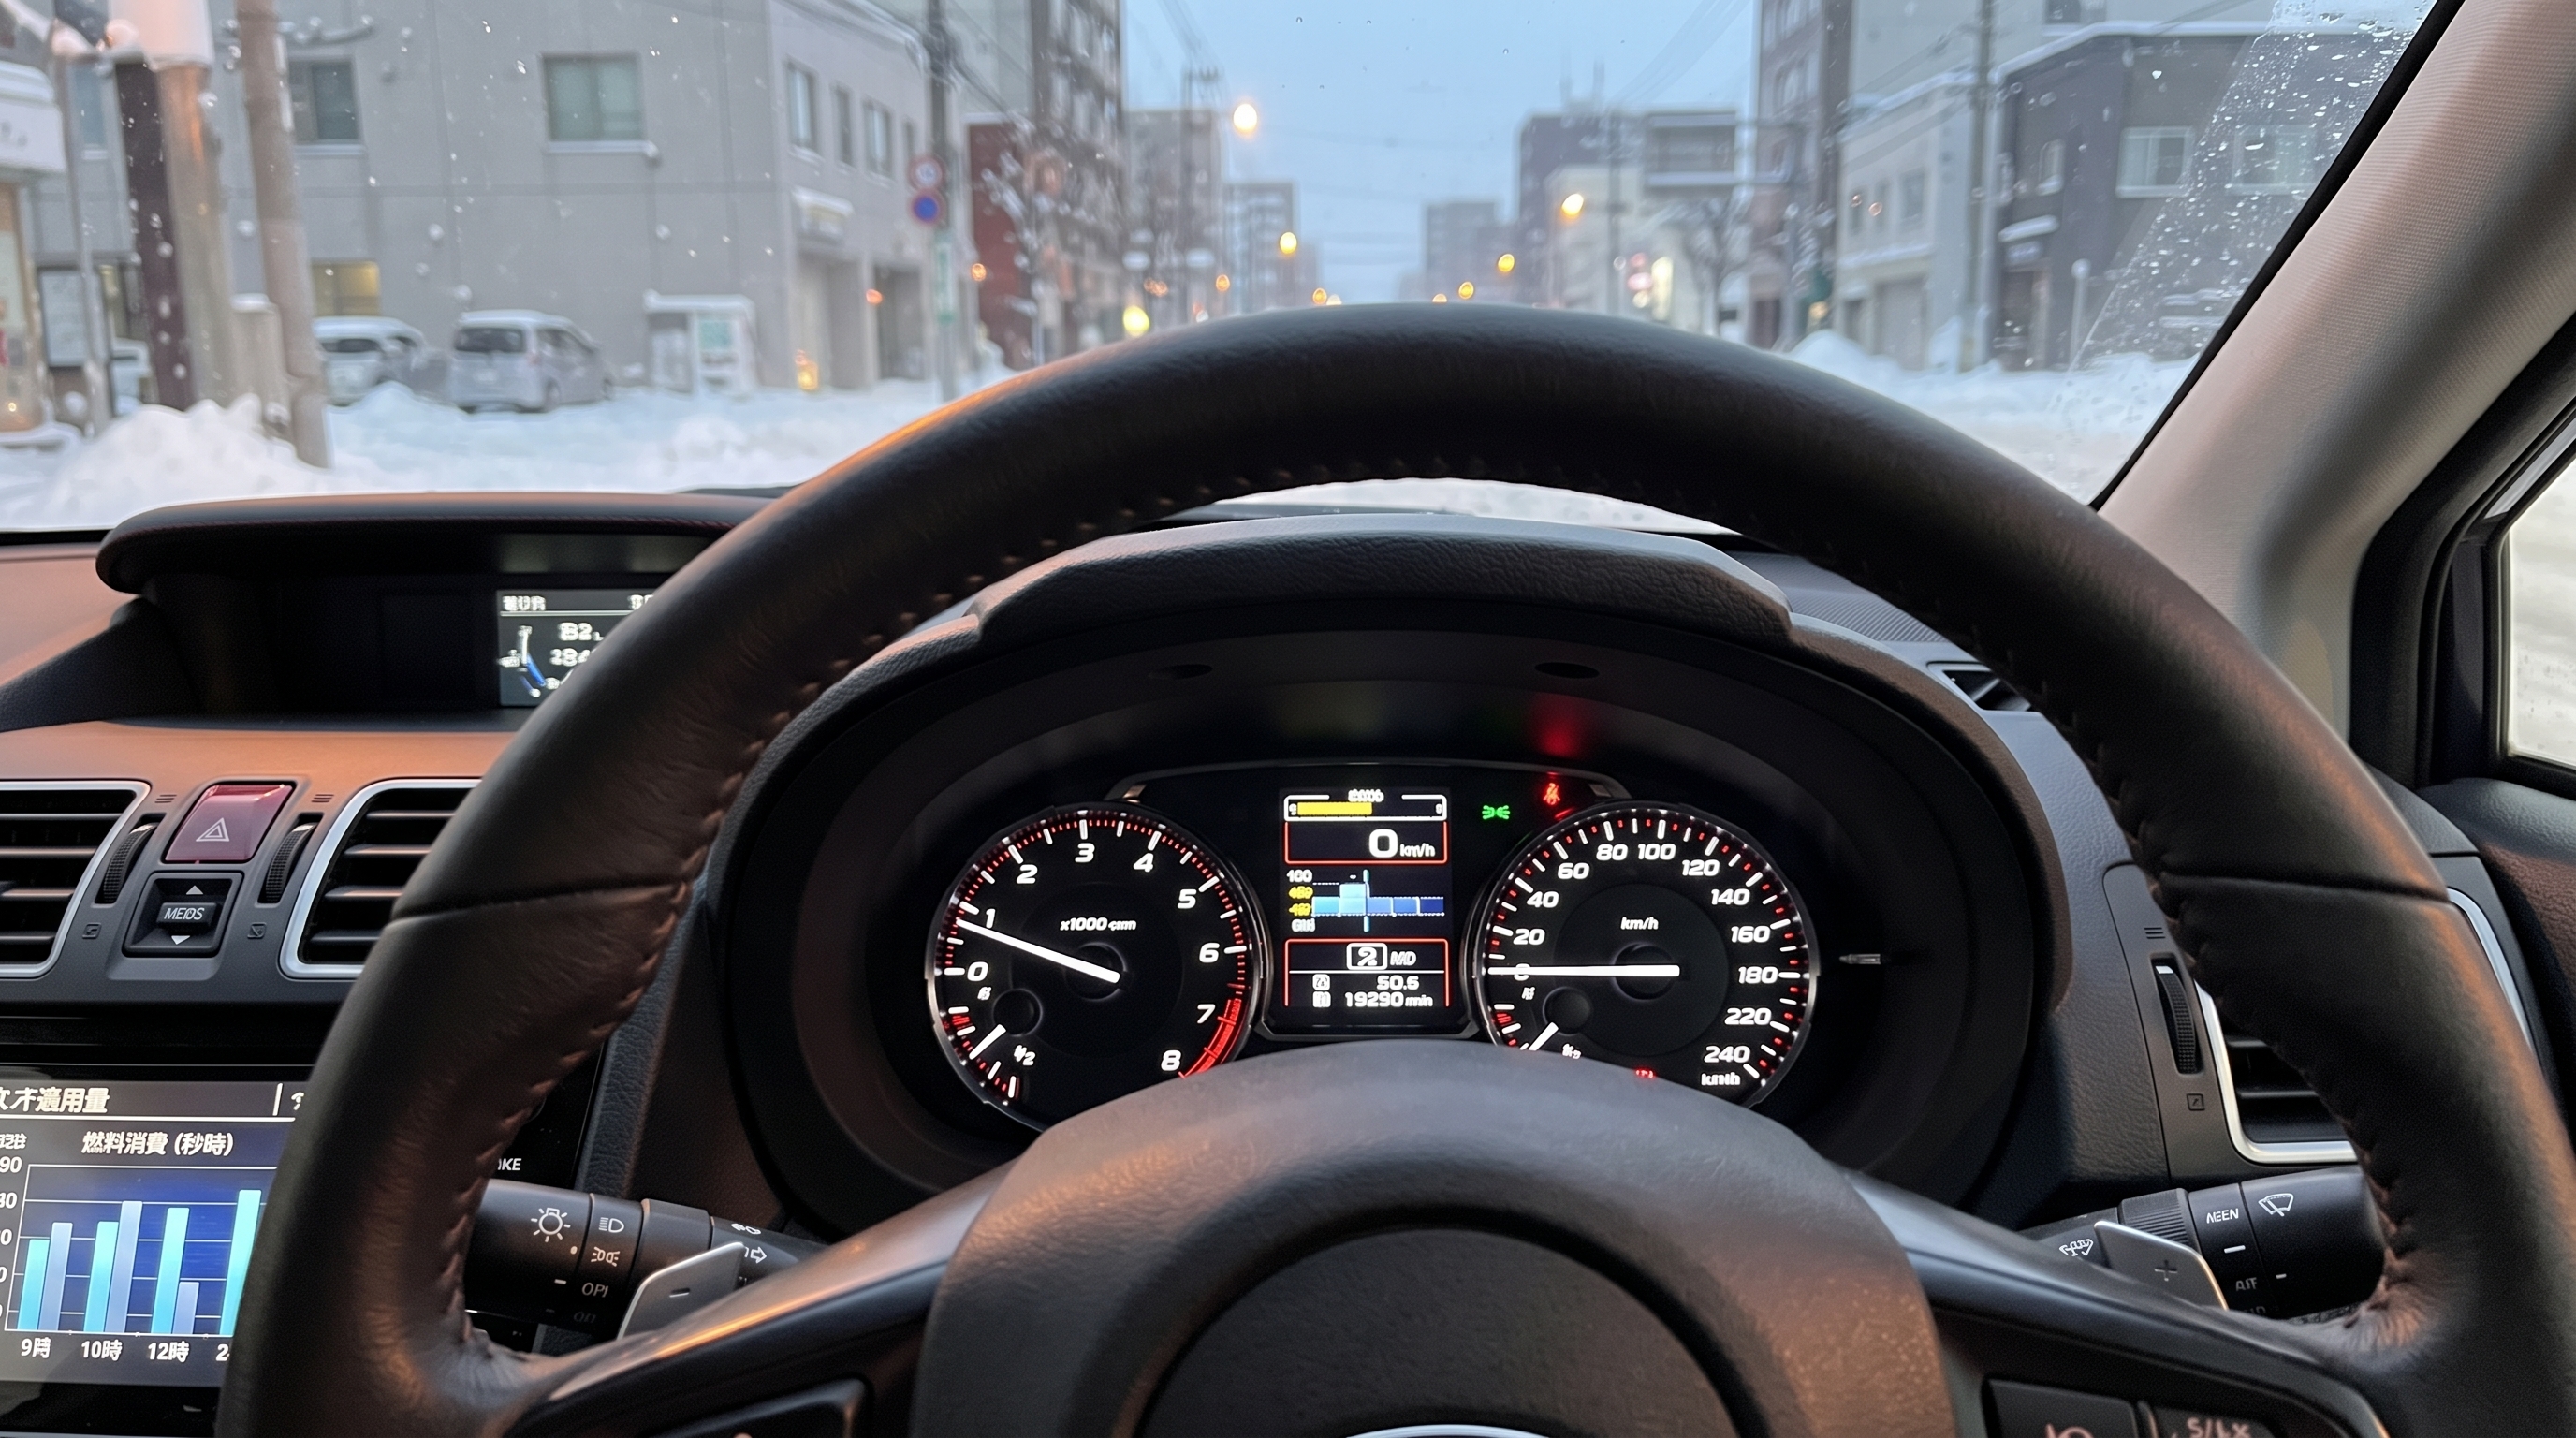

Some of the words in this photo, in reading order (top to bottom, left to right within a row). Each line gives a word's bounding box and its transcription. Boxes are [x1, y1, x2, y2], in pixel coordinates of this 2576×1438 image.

[1075, 843, 1095, 862] 3
[1368, 829, 1398, 858] 0
[1399, 844, 1436, 858] km/h
[1596, 844, 1628, 860] 80
[1638, 844, 1676, 860] 100
[1134, 854, 1154, 873] 4
[1558, 862, 1589, 879] 60
[1681, 859, 1720, 876] 120
[1017, 864, 1038, 884] 2
[1177, 889, 1196, 909] 5
[1527, 891, 1559, 908] 40
[1711, 888, 1750, 905] 140
[986, 908, 996, 928] 1
[1620, 917, 1659, 930] km/h
[1513, 928, 1545, 946] 20
[1731, 926, 1770, 943] 160
[1199, 943, 1220, 963] 6
[1357, 946, 1378, 966] 2
[967, 961, 988, 981] 0
[1737, 967, 1778, 984] 180
[1344, 991, 1404, 1007] 19290
[1197, 1005, 1215, 1023] 7
[1724, 1007, 1772, 1025] 220
[1161, 1050, 1181, 1071] 8
[1704, 1045, 1750, 1063] 240
[81, 1340, 123, 1361] 10時
[148, 1341, 190, 1363] 12時
